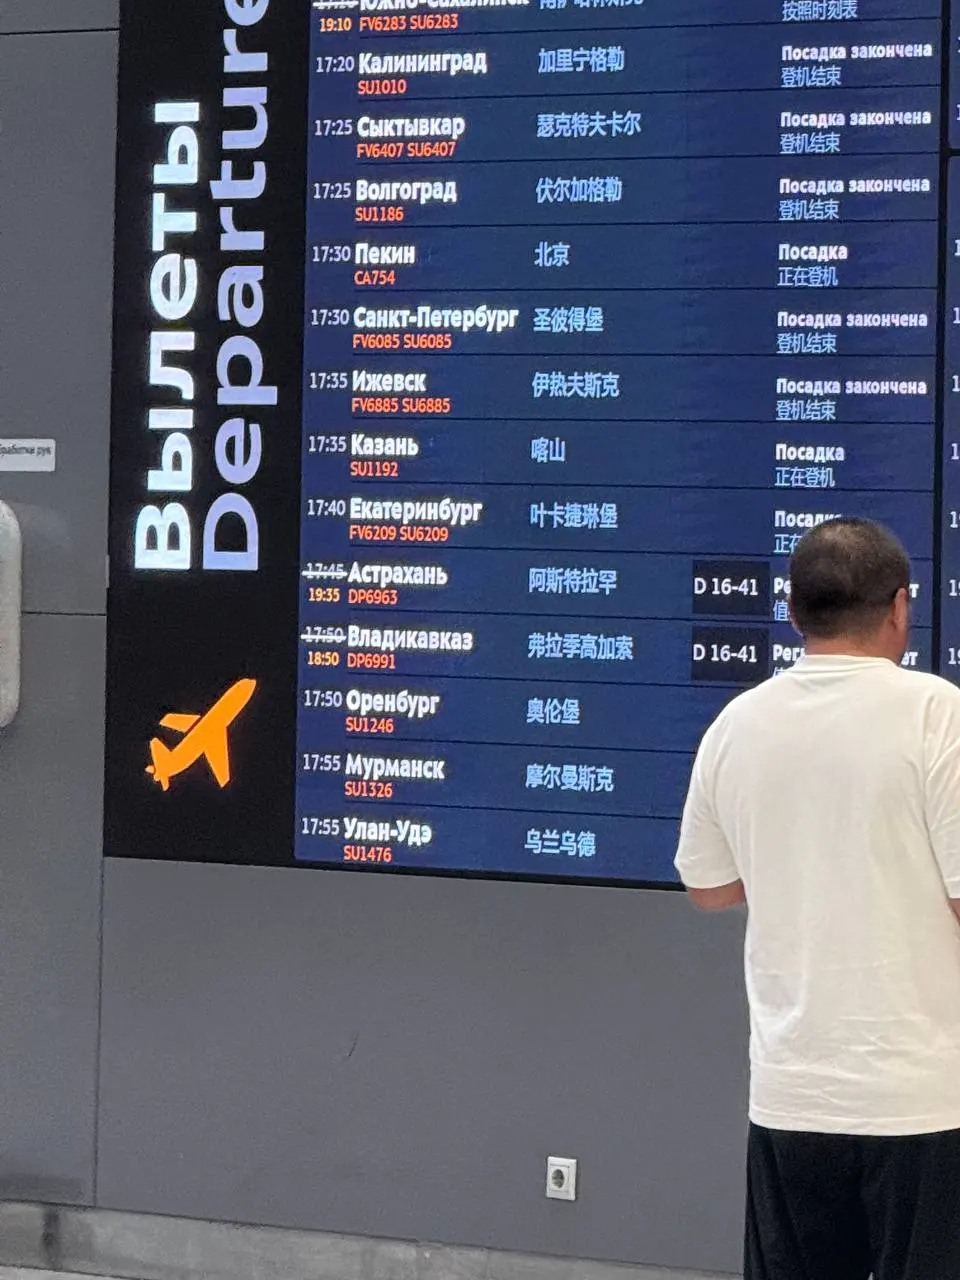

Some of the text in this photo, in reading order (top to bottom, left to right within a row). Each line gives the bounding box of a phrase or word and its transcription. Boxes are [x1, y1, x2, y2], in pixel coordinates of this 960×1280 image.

[358, 52, 488, 77] Калининград
[358, 79, 407, 95] SU1010
[356, 115, 466, 141] Сыктывкар
[355, 179, 458, 205] Волгоград
[312, 242, 416, 265] 17:30 Пекин
[533, 240, 571, 268] 北京
[354, 270, 396, 285] CA754
[352, 304, 520, 334] Санкт-Петербург
[134, 101, 200, 570] Вылеты
[352, 369, 427, 393] Ижевск
[350, 433, 419, 456] Казань
[349, 497, 483, 526] Екатеринбург
[347, 561, 449, 589] Астрахань
[347, 624, 474, 652] Владикавказ
[345, 688, 441, 719] Оренбург
[344, 753, 445, 781] Мурманск
[343, 817, 433, 847] Улан-Удэ
